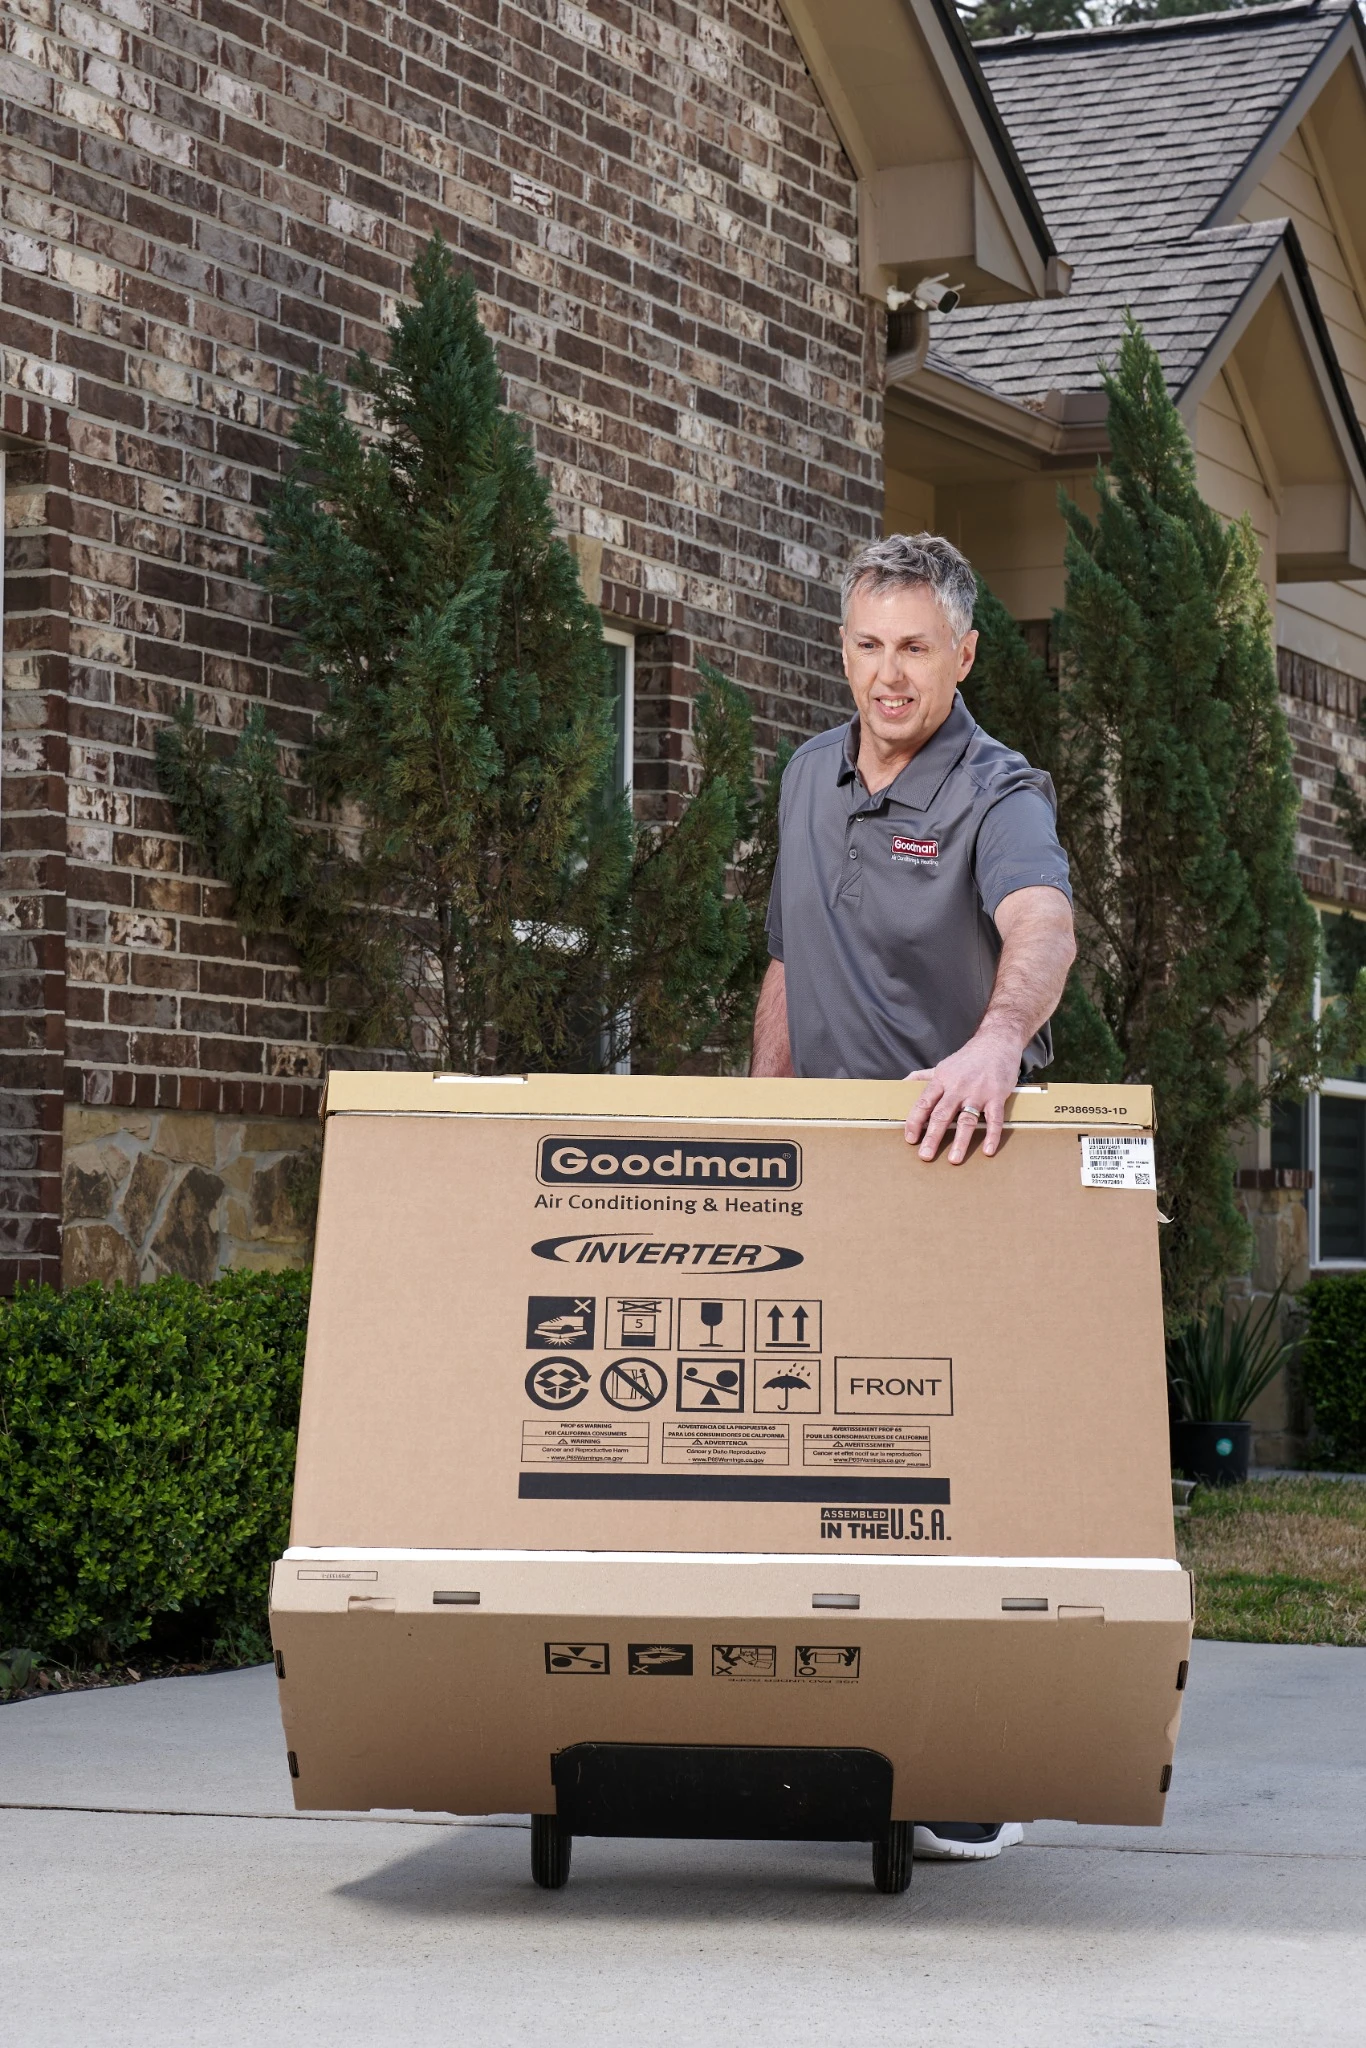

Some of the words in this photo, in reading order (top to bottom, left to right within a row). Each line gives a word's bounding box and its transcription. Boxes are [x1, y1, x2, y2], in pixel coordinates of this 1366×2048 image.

[895, 840, 935, 853] Goodman
[1054, 1106, 1127, 1115] 2P386953-1D
[534, 1194, 562, 1208] Air
[568, 1194, 697, 1214] Conditioning
[702, 1198, 718, 1212] &
[726, 1198, 803, 1216] Heating
[576, 1242, 762, 1266] INVERTER
[635, 1319, 643, 1328] 5
[850, 1378, 942, 1396] FRONT
[823, 1510, 886, 1519] ASSEMBLED
[821, 1522, 841, 1538] IN
[848, 1523, 889, 1539] THE
[891, 1508, 951, 1540] U.S.A.
